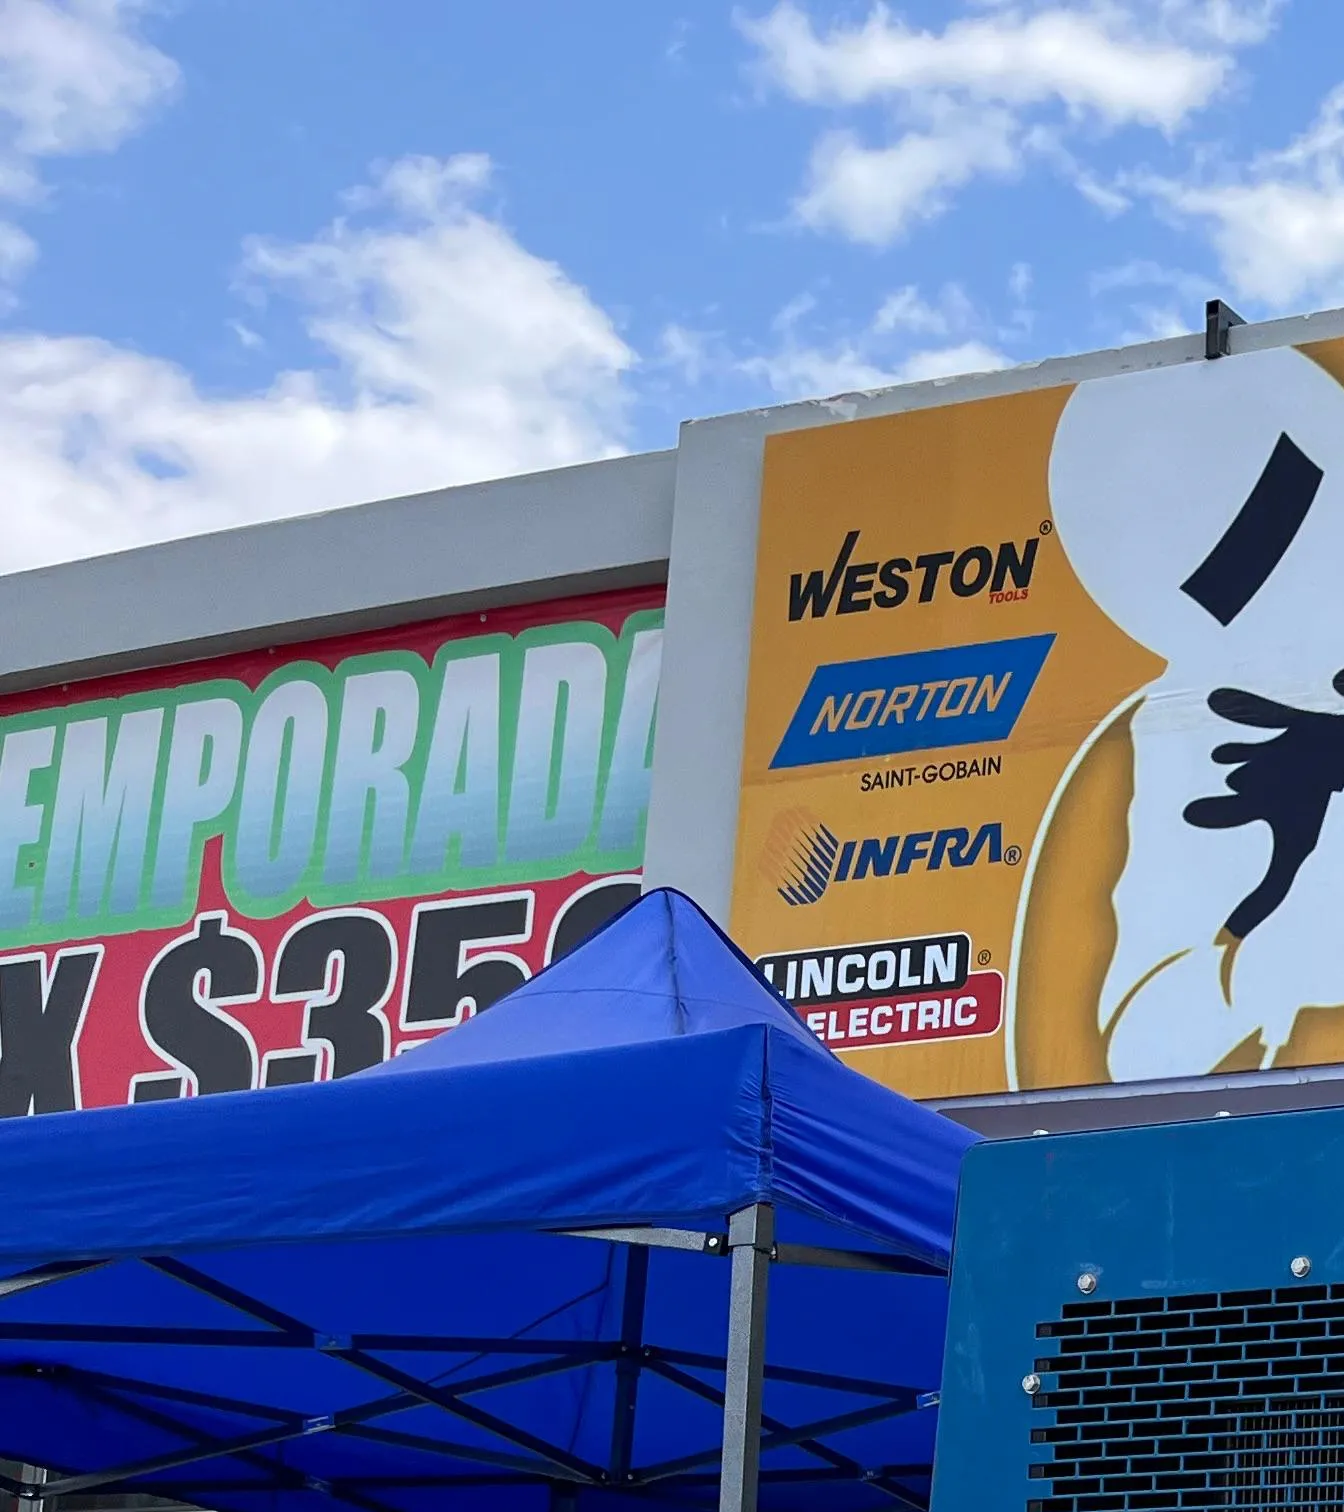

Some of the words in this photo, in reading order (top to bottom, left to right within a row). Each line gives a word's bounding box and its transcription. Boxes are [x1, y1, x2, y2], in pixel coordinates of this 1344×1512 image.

[787, 530, 1040, 622] WESTON
[988, 588, 1029, 605] TOOLS
[809, 671, 1013, 737] NORTON
[860, 755, 1002, 793] SAINT-GOBAIN
[833, 822, 1002, 883] INFRA
[130, 873, 645, 1105] $35
[763, 942, 959, 1002] LINCOLN
[806, 995, 979, 1042] ELECTRIC
